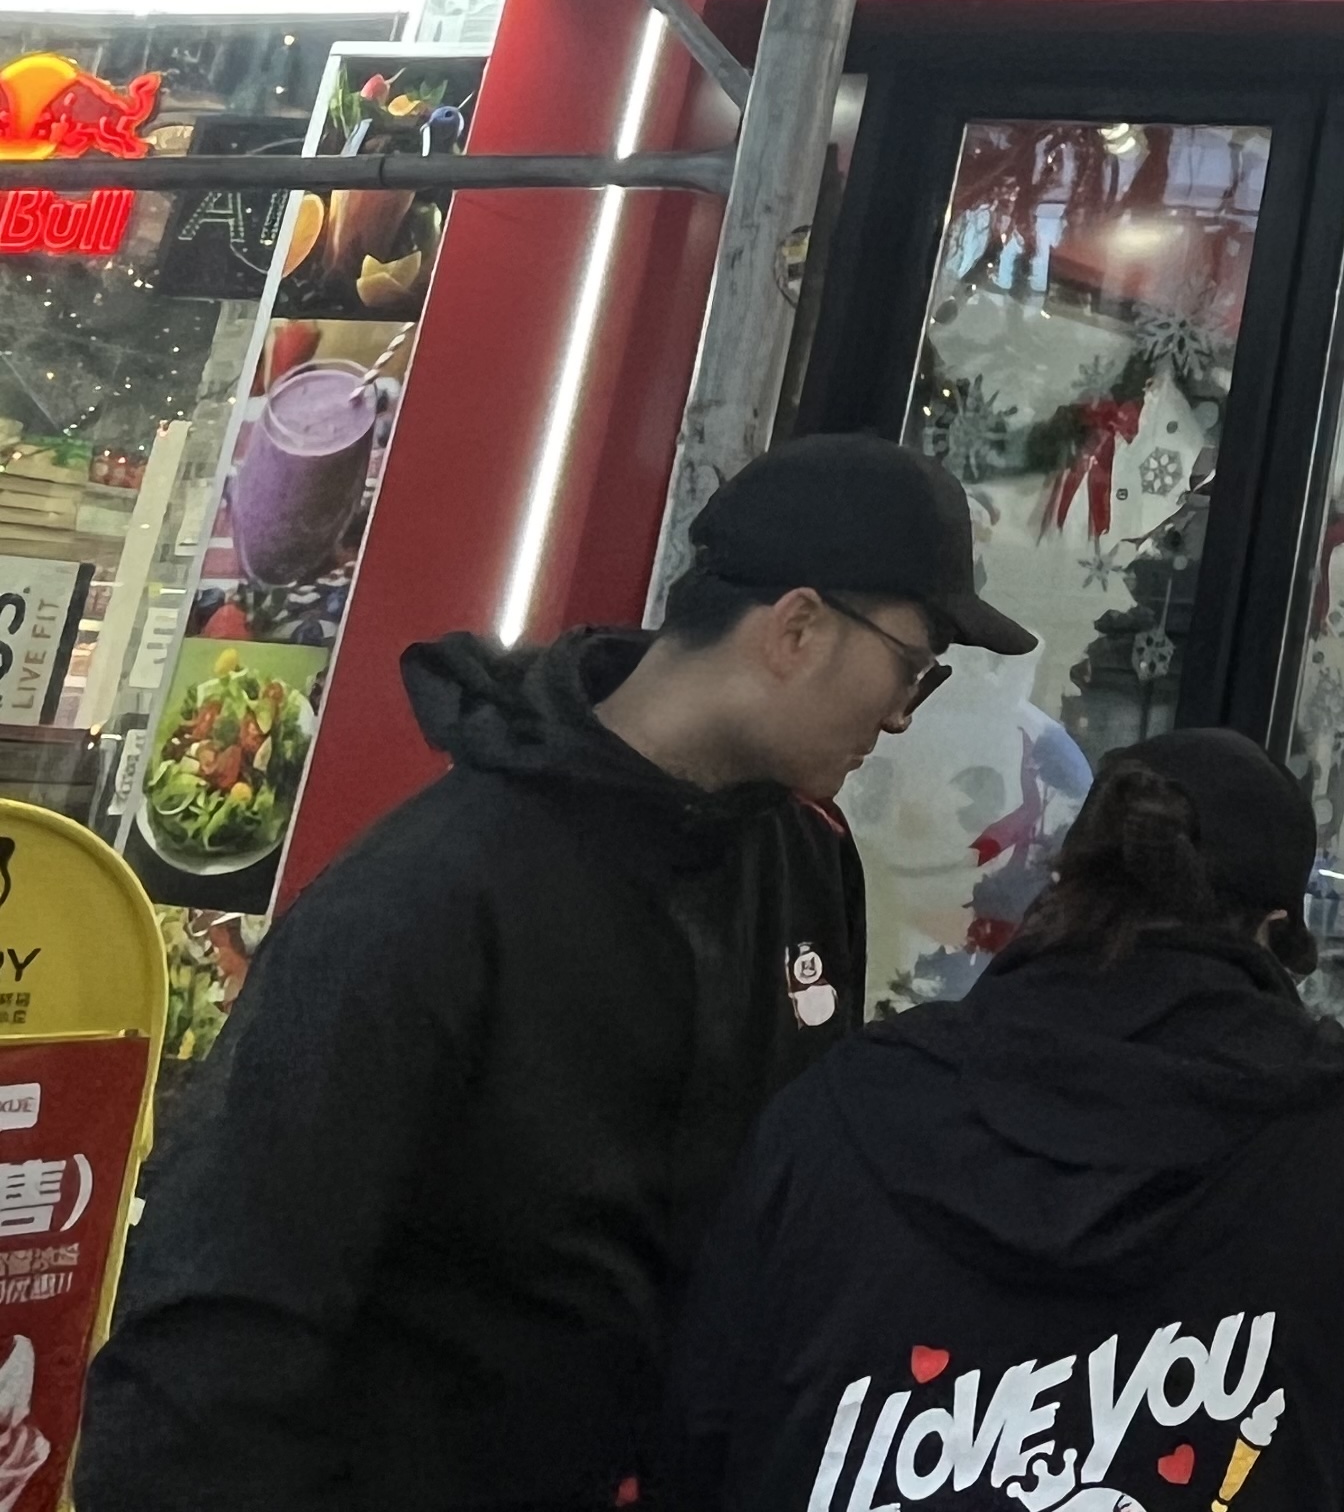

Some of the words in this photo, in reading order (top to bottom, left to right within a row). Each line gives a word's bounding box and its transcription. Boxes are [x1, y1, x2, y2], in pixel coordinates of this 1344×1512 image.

[12, 650, 47, 709] LIVE
[31, 598, 59, 639] FIT
[808, 1375, 872, 1512] I
[847, 1355, 1077, 1512] LOVE
[1081, 1311, 1276, 1483] YOU
